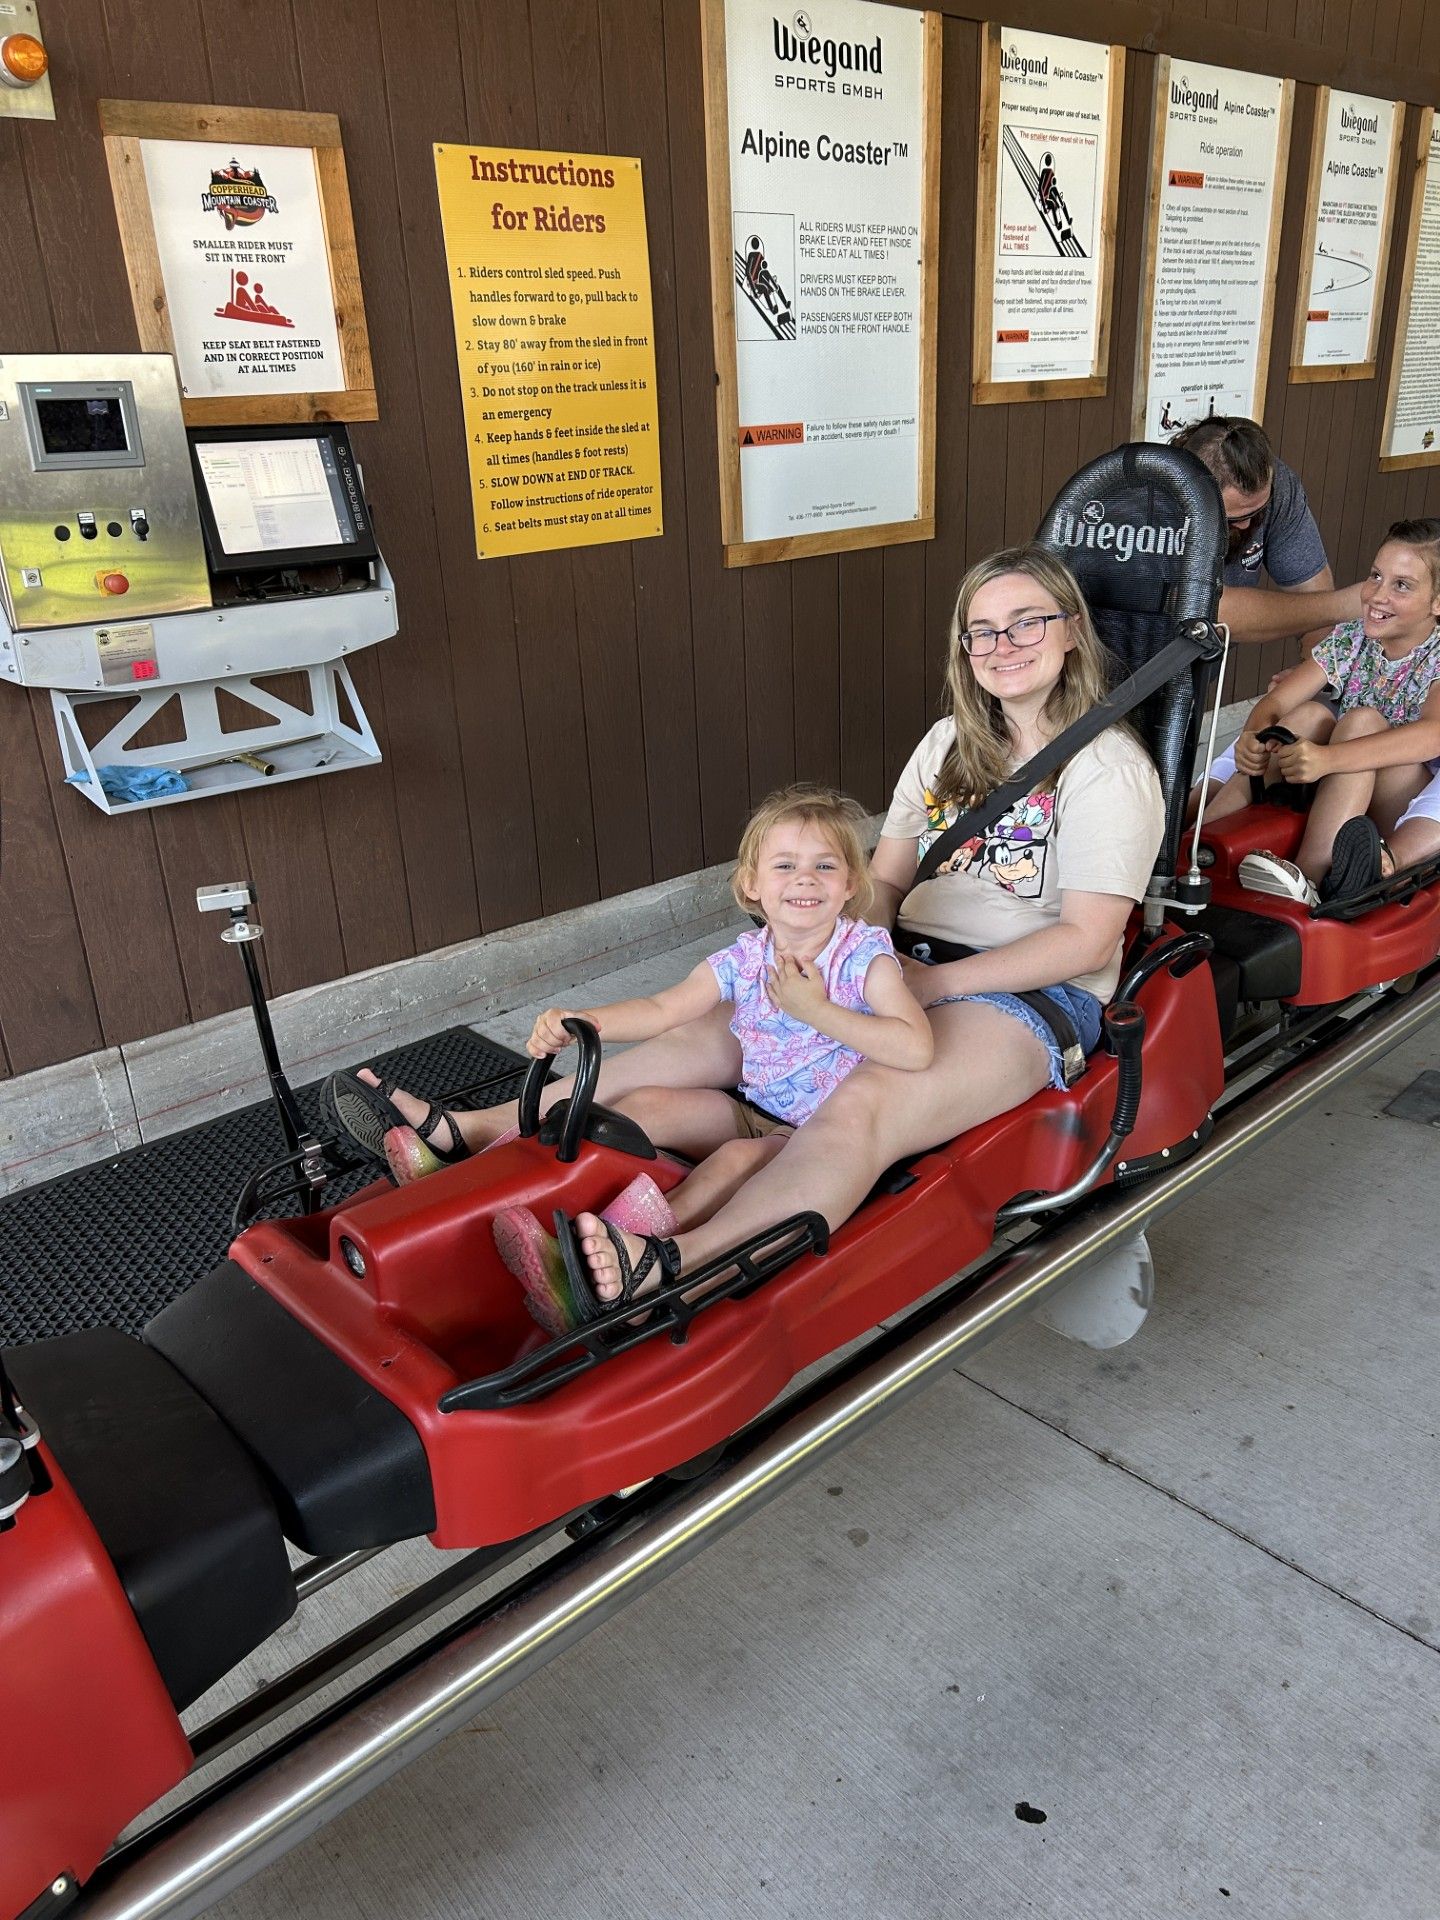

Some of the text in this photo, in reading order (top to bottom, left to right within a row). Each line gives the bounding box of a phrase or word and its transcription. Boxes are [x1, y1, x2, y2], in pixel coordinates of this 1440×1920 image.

[773, 13, 882, 77] Wiegand
[1001, 46, 1048, 76] Wiegand
[1053, 67, 1073, 79] Alpine
[775, 75, 882, 100] SPORTS GMBH
[1000, 75, 1048, 88] SPORTS GMBH
[1171, 80, 1218, 112] Wiegand
[1224, 101, 1244, 114] Alpine
[1002, 102, 1018, 111] Proper
[1020, 104, 1037, 114] seating
[1050, 108, 1065, 117] proper
[1170, 111, 1217, 124] SPORTS GMBH
[1341, 108, 1378, 135] Wiegand
[741, 128, 810, 163] Alpine
[1340, 134, 1359, 143] SPORTS
[1200, 142, 1243, 158] Ride operation
[469, 155, 615, 188] Instructions
[1327, 160, 1349, 176] Alpine
[212, 186, 264, 196] COPPERHEAD
[202, 194, 278, 212] MOUNTAIN COASTER
[492, 203, 606, 233] for Riders
[800, 222, 918, 236] ALL RIDERS MUST KEEP HAND ON
[193, 240, 293, 250] SMALLER RIDER MUST
[800, 235, 911, 248] BRAKE LEVER AND FEET INSIDE
[206, 253, 220, 262] SIT
[222, 254, 232, 262] IN
[235, 254, 254, 262] THE
[800, 248, 815, 257] THE
[817, 249, 837, 258] SLED
[838, 250, 848, 258] AT
[850, 250, 862, 259] ALL
[457, 267, 621, 281] 1. Riders control sled speed. Push
[800, 274, 896, 284] DRIVERS MUST KEEP BOTH
[470, 291, 638, 305] handles forward to go, pull back to
[800, 287, 906, 297] HANDS ON THE BRAKE LEVER.
[473, 315, 566, 326] slow down & brake
[801, 312, 912, 322] PASSENGERS MUST KEEP BOTH
[801, 324, 827, 334] HANDS
[829, 324, 839, 333] ON
[841, 324, 856, 334] THE
[857, 324, 881, 333] FRONT
[229, 341, 251, 349] SEAT
[277, 340, 320, 348] FASTENED
[465, 341, 474, 350] 2.
[477, 340, 500, 352] Stay
[521, 340, 546, 350] away
[550, 338, 573, 348] from
[575, 338, 590, 348] the
[593, 337, 611, 347] sled
[613, 337, 622, 347] in
[625, 336, 648, 346] front
[204, 354, 224, 362] AND
[239, 352, 280, 361] CORRECT
[282, 351, 323, 360] POSITION
[270, 364, 296, 372] TIMES
[477, 363, 489, 373] of
[491, 364, 509, 376] you
[538, 361, 548, 371] in
[550, 361, 570, 371] rain
[573, 362, 582, 370] or
[585, 359, 600, 371] ice)
[1181, 384, 1203, 393] operation
[482, 408, 552, 422] an emergency
[757, 428, 801, 441] WARNING
[480, 465, 635, 488] 5. SLOW DOWN at END OF TRACK.
[483, 506, 651, 533] 6. Seat belts must stay on at all times
[1052, 507, 1191, 562] Wiegand
